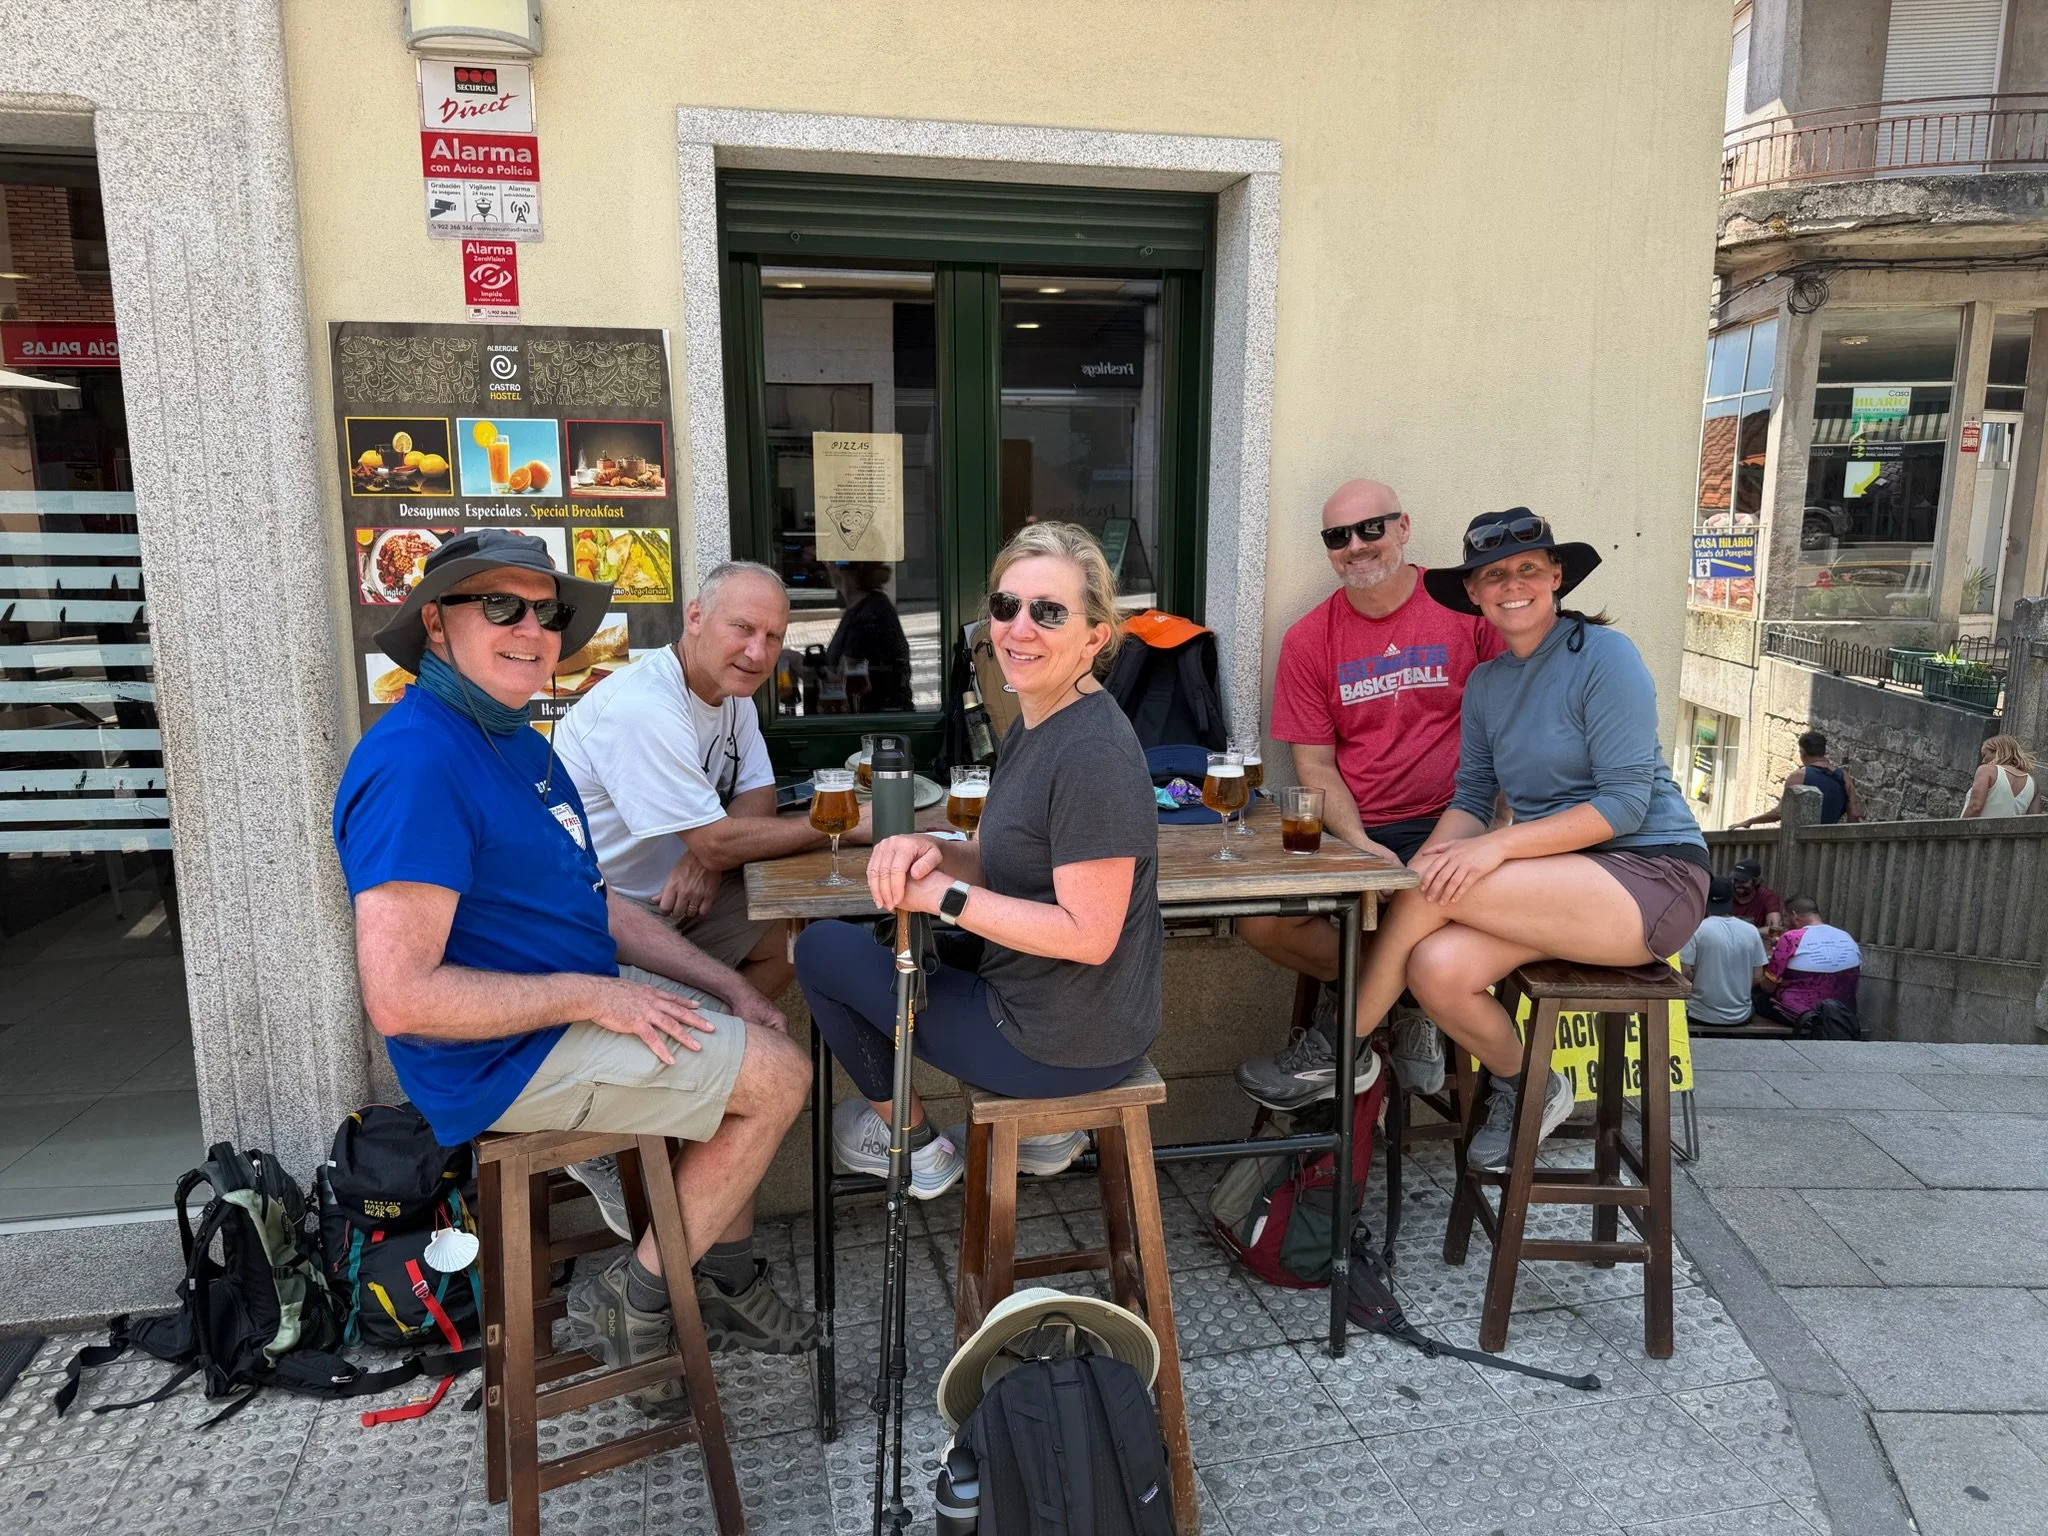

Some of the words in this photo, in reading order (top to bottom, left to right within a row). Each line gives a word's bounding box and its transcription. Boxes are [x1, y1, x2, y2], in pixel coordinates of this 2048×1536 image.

[456, 84, 496, 93] SECURITAS
[438, 93, 520, 123] Direct
[430, 138, 532, 163] Alarma
[430, 164, 450, 173] con
[454, 163, 484, 174] Aviso
[487, 167, 494, 175] a
[497, 165, 533, 176] Policía
[430, 182, 461, 190] Grabación
[465, 242, 513, 255] Alarma
[489, 383, 521, 391] CASTRO
[490, 392, 522, 400] HOSTEL
[1855, 397, 1908, 407] HILARIO
[831, 441, 870, 450] PIZZAS
[399, 503, 460, 520] Desayunos
[465, 503, 522, 520] Especiales
[530, 503, 569, 520] Special
[572, 504, 624, 518] Breakfast
[1694, 537, 1717, 549] CASA
[1719, 537, 1753, 548] HILARIO
[1340, 666, 1449, 701] BASKETBALL
[860, 1138, 890, 1158] HOK
